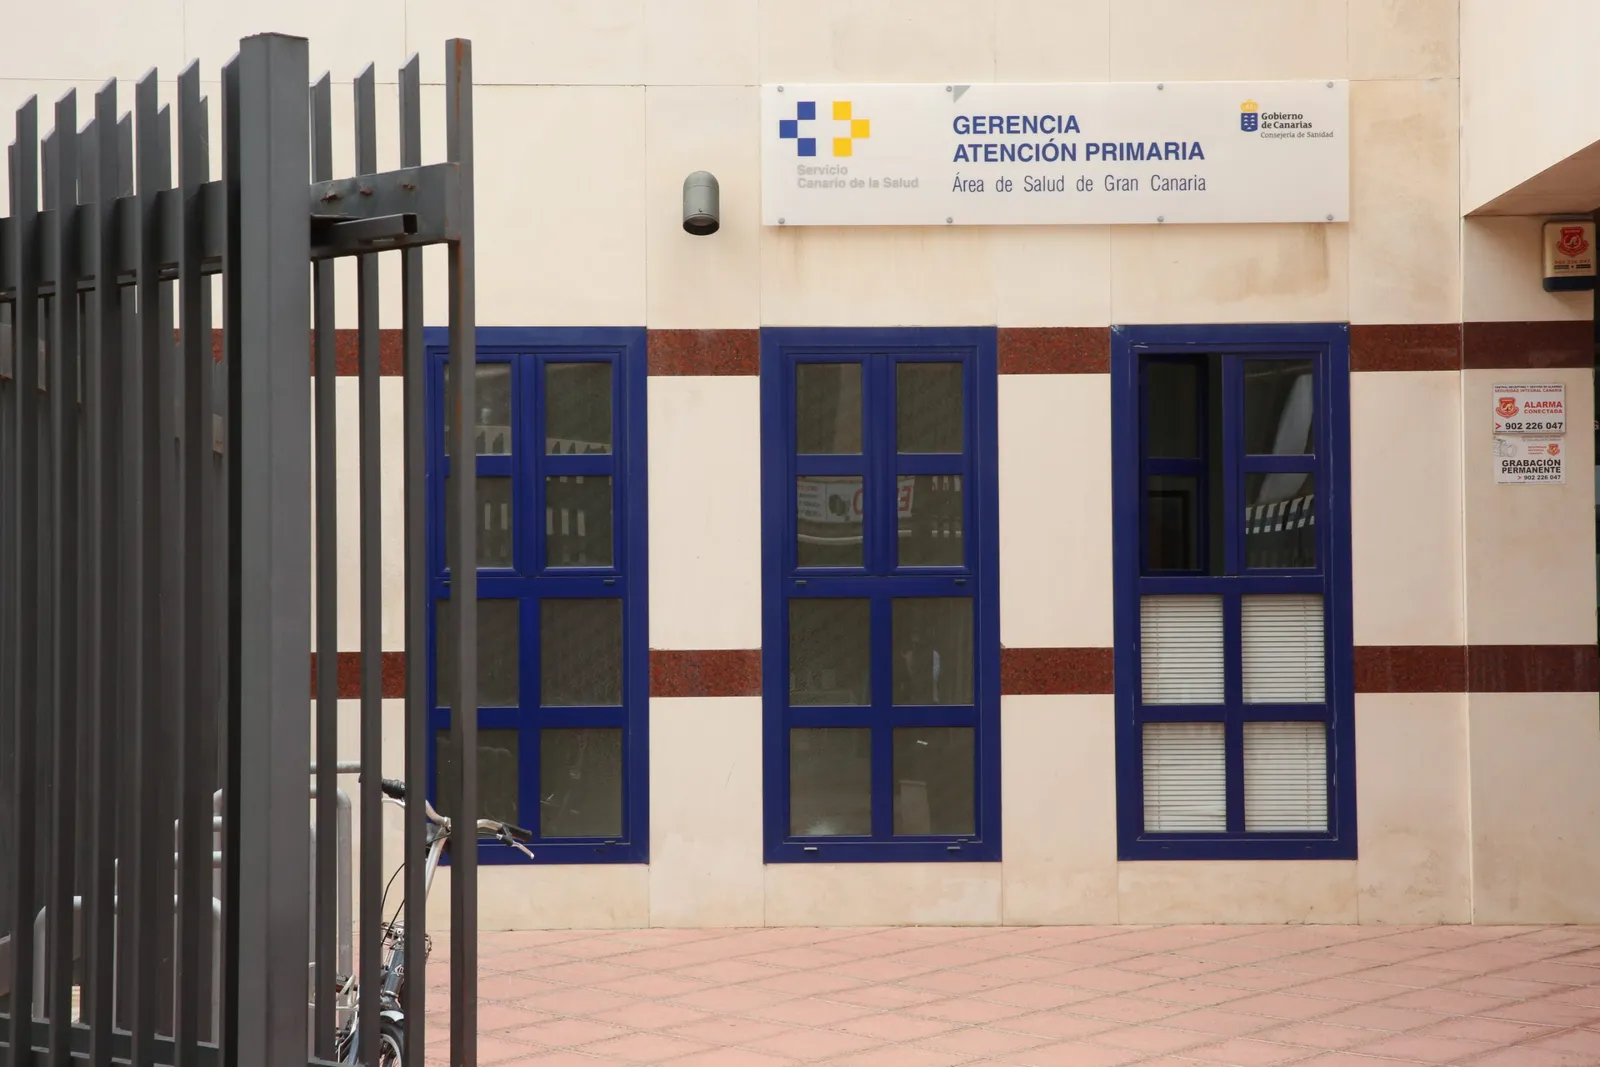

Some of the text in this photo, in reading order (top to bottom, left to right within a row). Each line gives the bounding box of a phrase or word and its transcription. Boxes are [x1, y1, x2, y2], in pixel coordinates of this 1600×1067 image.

[1261, 112, 1304, 121] Gobierno
[953, 115, 1080, 134] GERENCIA
[1261, 121, 1313, 129] de Canarias
[1306, 130, 1334, 138] Sanidad
[953, 138, 1205, 162] ATENCIÓN PRIMARIA
[797, 164, 848, 176] Servicio
[797, 177, 919, 189] Canario de la Salud
[952, 172, 1206, 193] Área de Salud de Gran Canaria
[1505, 422, 1563, 430] 902 226 047
[1502, 459, 1561, 467] GRABACIÓN
